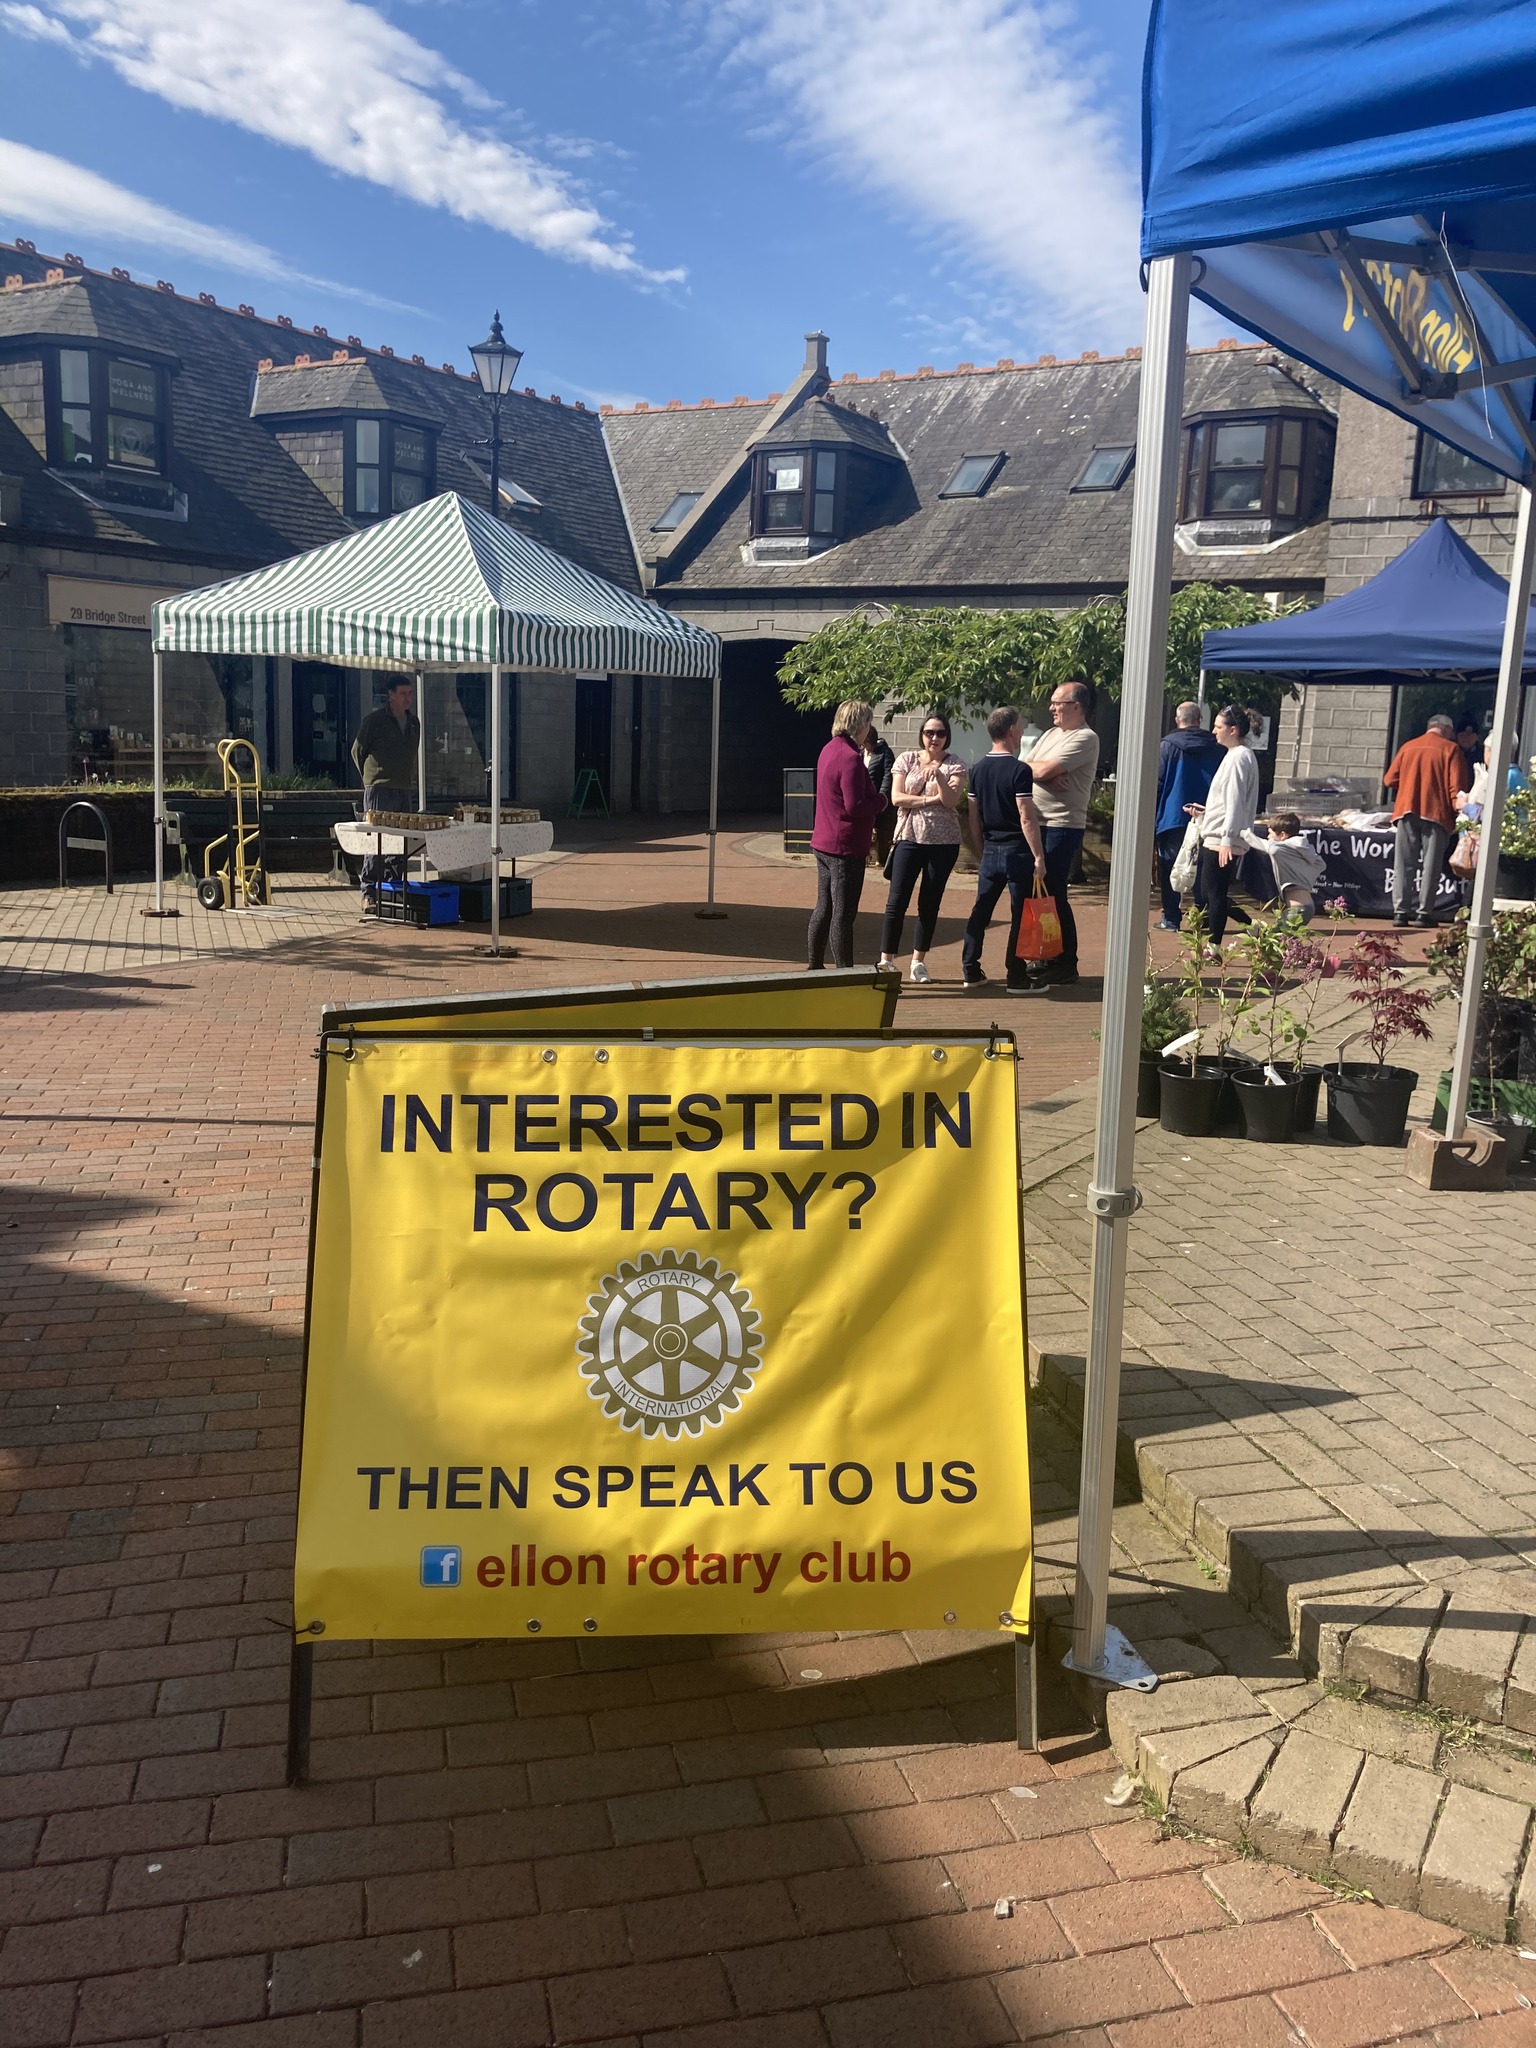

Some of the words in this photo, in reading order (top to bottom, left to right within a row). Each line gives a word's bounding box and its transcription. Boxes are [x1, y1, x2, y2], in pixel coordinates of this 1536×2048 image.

[111, 377, 134, 389] YOGA
[137, 383, 153, 394] AND
[111, 387, 155, 403] WELLNESS
[70, 607, 83, 620] 29
[85, 609, 115, 624] Bridge
[118, 612, 146, 625] Street
[1299, 829, 1342, 856] The
[379, 1093, 881, 1153] INTERESTED
[901, 1091, 972, 1149] IN
[473, 1171, 877, 1232] ROTARY?
[637, 1271, 702, 1292] ROTARY
[613, 1379, 729, 1416] INTERNATIONAL
[356, 1466, 529, 1511] THEN
[552, 1464, 770, 1509] SPEAK
[789, 1461, 873, 1506] TO
[895, 1460, 978, 1504] US
[476, 1543, 606, 1588] ellon
[627, 1542, 782, 1594] rotary
[800, 1540, 912, 1583] club
